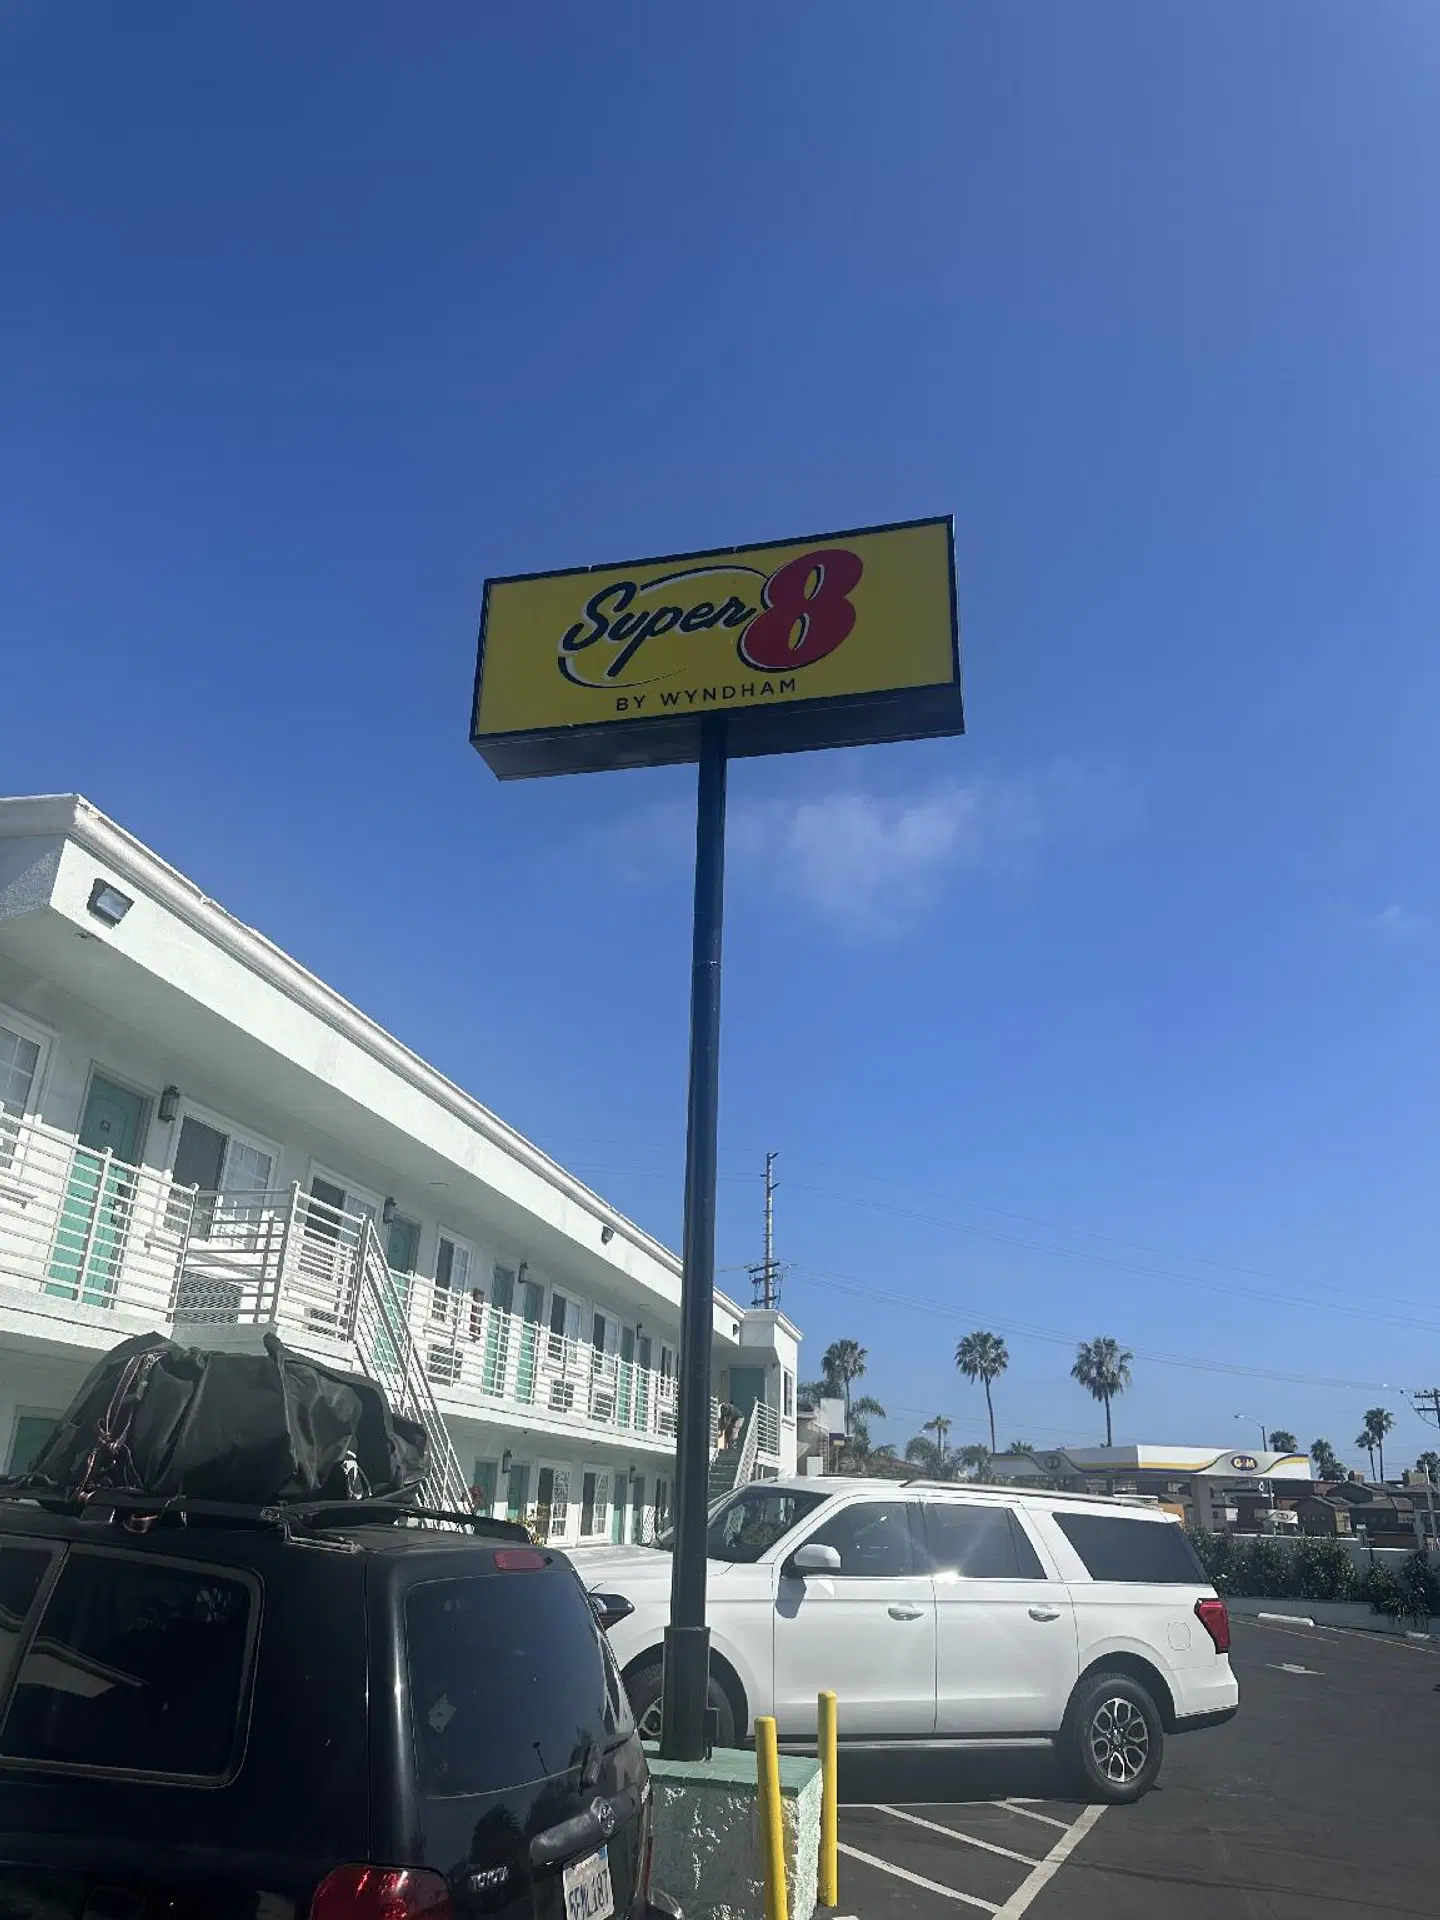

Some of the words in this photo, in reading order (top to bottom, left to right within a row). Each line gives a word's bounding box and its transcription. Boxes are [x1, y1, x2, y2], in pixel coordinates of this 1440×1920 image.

[559, 580, 759, 679] Super
[738, 549, 864, 673] 8
[616, 695, 646, 711] BY
[660, 678, 796, 707] WYNDHAM
